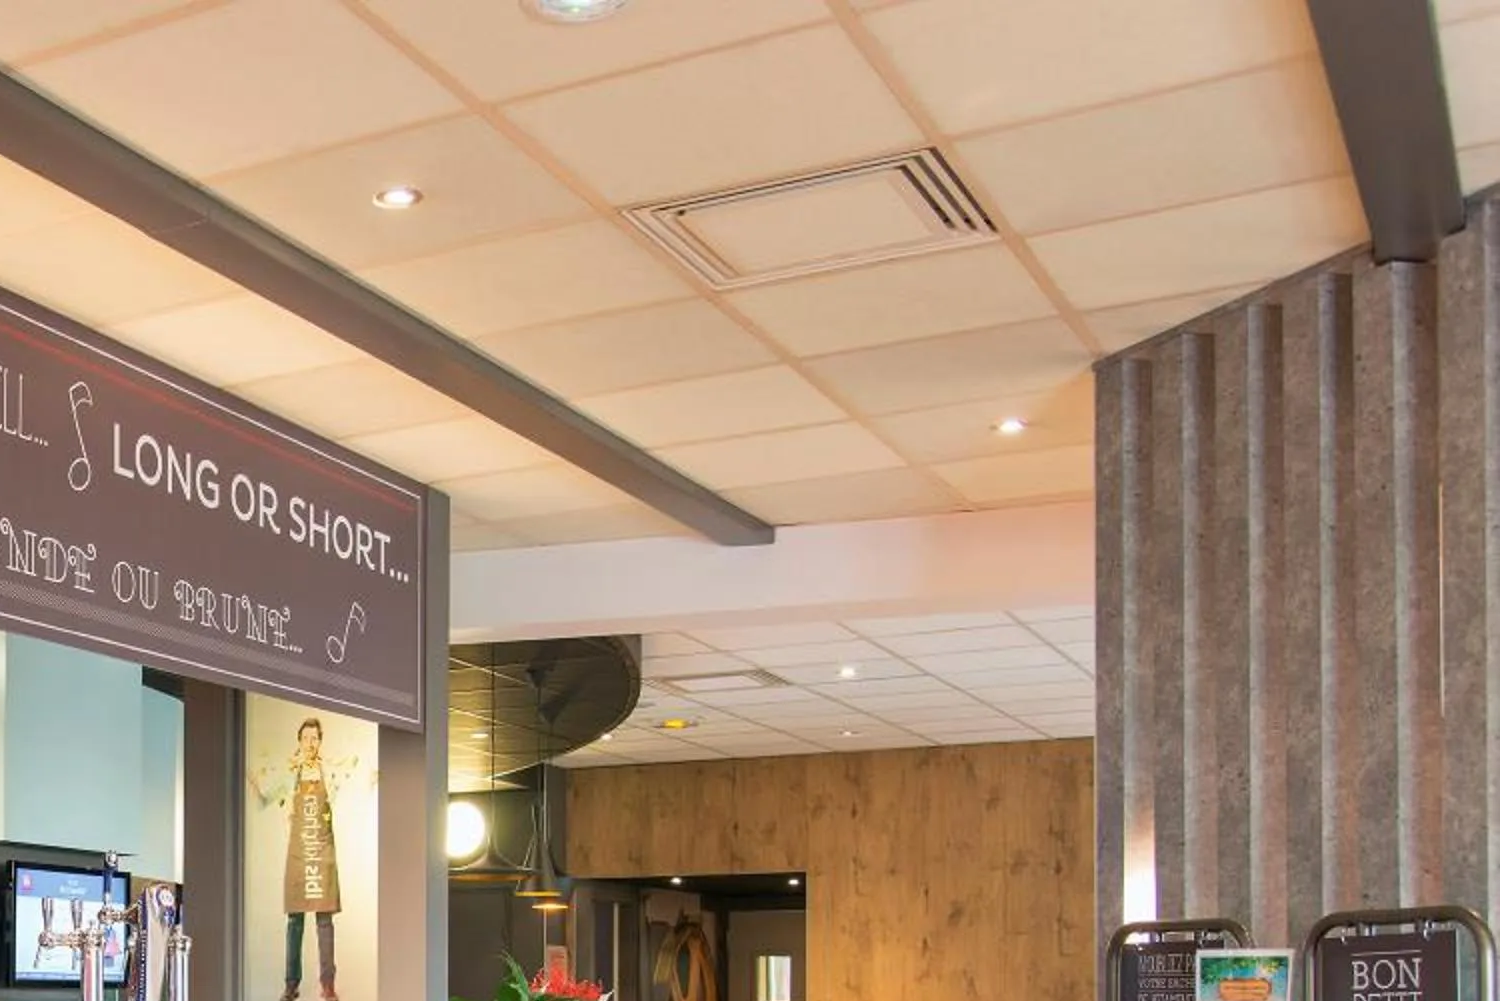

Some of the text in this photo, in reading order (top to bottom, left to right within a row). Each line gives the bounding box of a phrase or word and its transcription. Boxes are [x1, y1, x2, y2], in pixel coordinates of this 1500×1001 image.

[113, 422, 220, 510] LONG
[231, 473, 281, 535] OR
[111, 560, 160, 610] OU
[1351, 957, 1423, 990] BON
